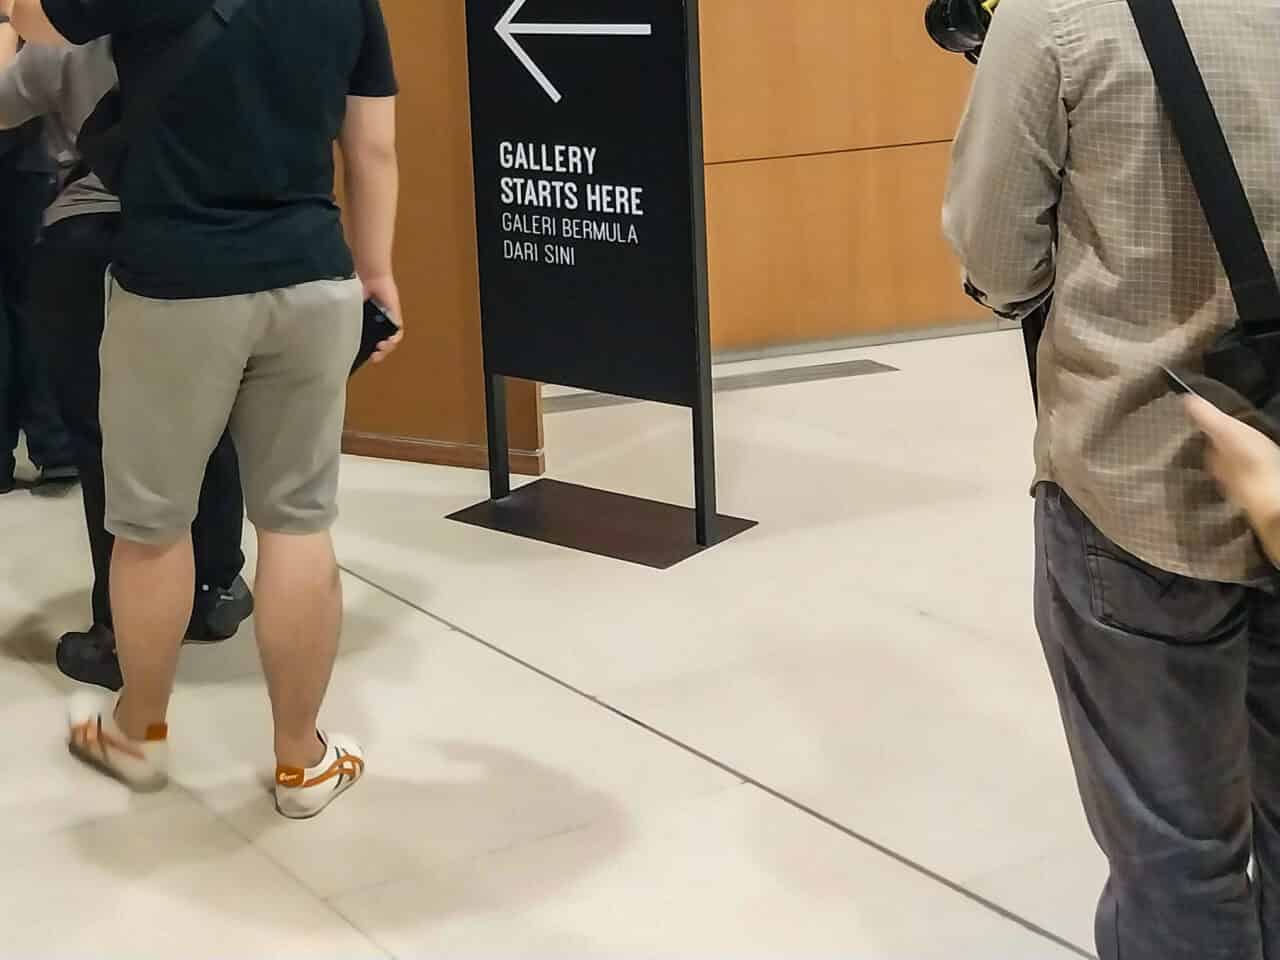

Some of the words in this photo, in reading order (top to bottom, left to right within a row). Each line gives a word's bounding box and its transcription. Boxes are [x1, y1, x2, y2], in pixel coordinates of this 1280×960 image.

[499, 141, 597, 175] GALLERY
[500, 177, 578, 209] STARTS
[586, 183, 644, 216] HERE
[502, 212, 557, 236] GALERI
[562, 218, 639, 244] BERMULA
[503, 240, 538, 262] DARI
[544, 244, 575, 266] SINI
